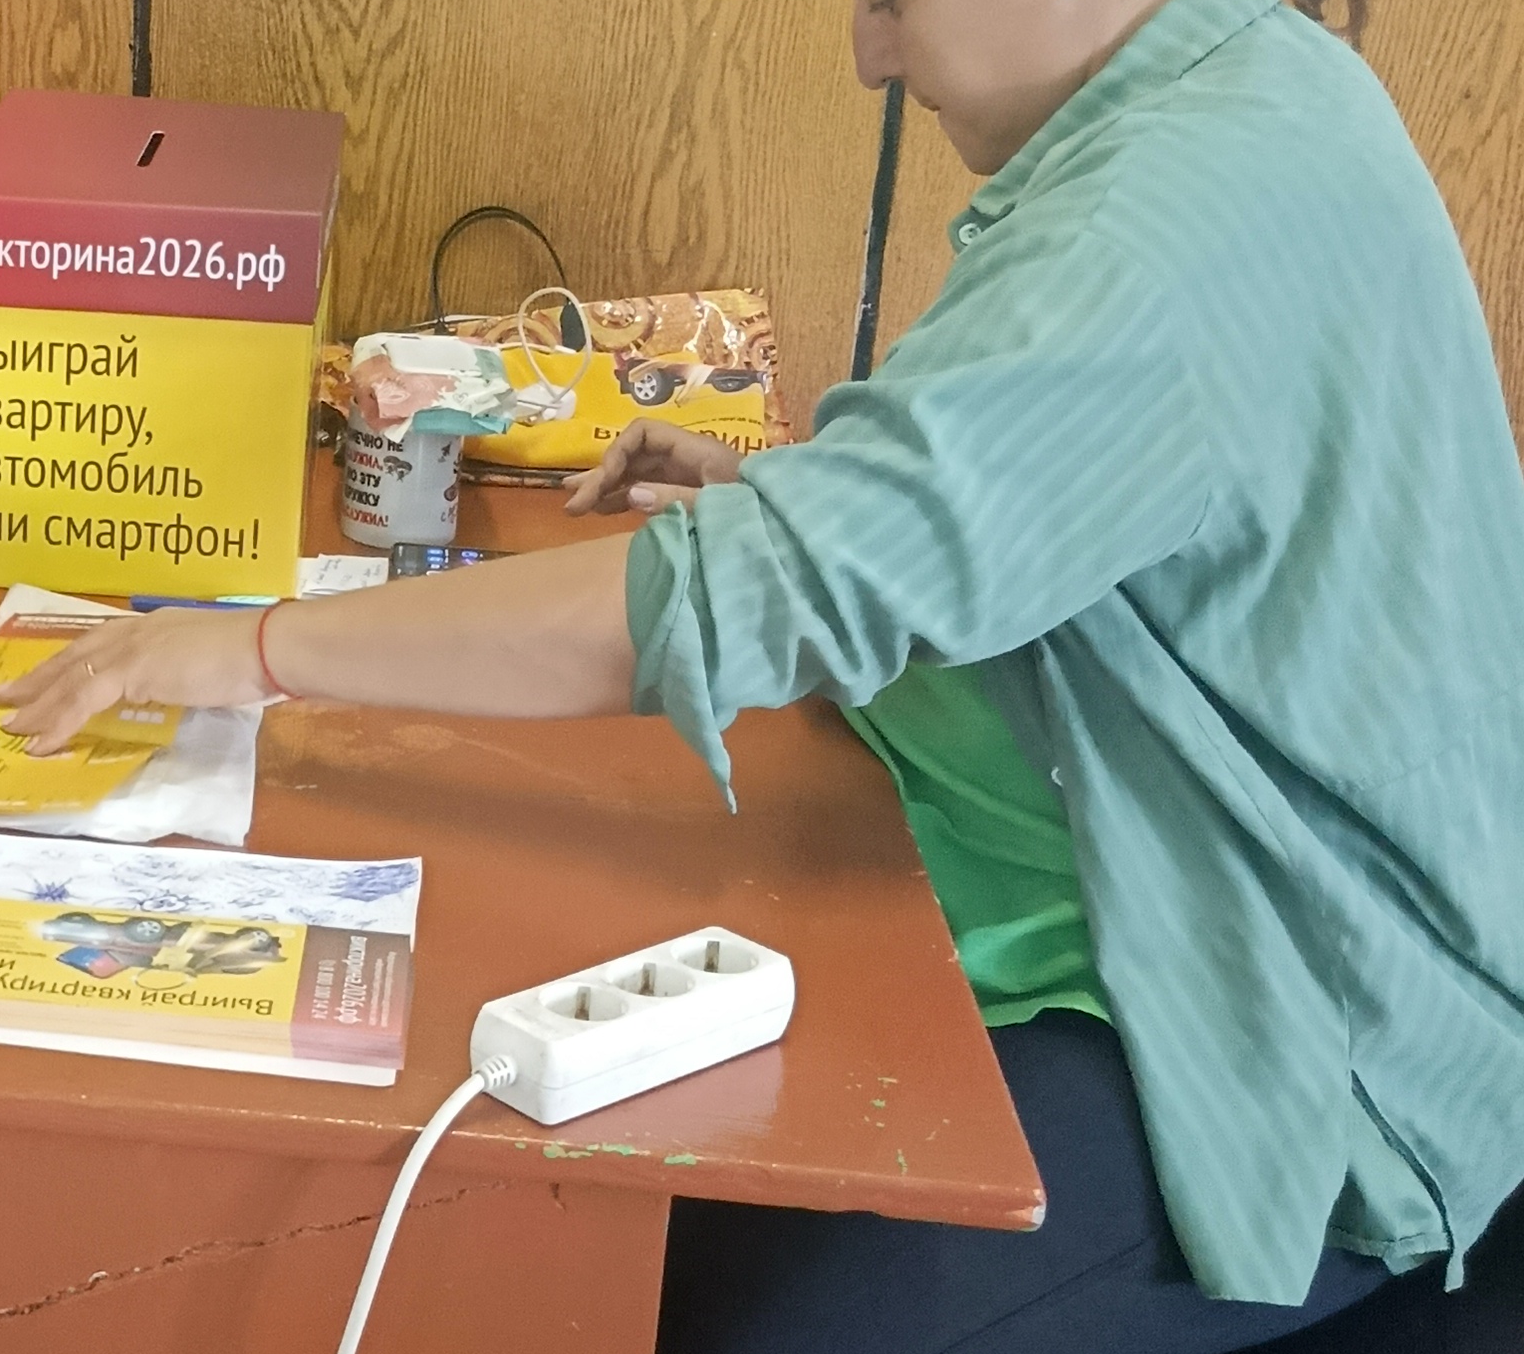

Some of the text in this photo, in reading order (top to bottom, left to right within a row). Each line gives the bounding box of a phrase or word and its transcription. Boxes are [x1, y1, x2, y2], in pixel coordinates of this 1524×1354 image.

[359, 472, 382, 488] ЭТУ
[44, 513, 261, 565] смартфон!
[334, 936, 368, 1025] викторина2026.рф
[140, 988, 274, 1016] Выиграй
